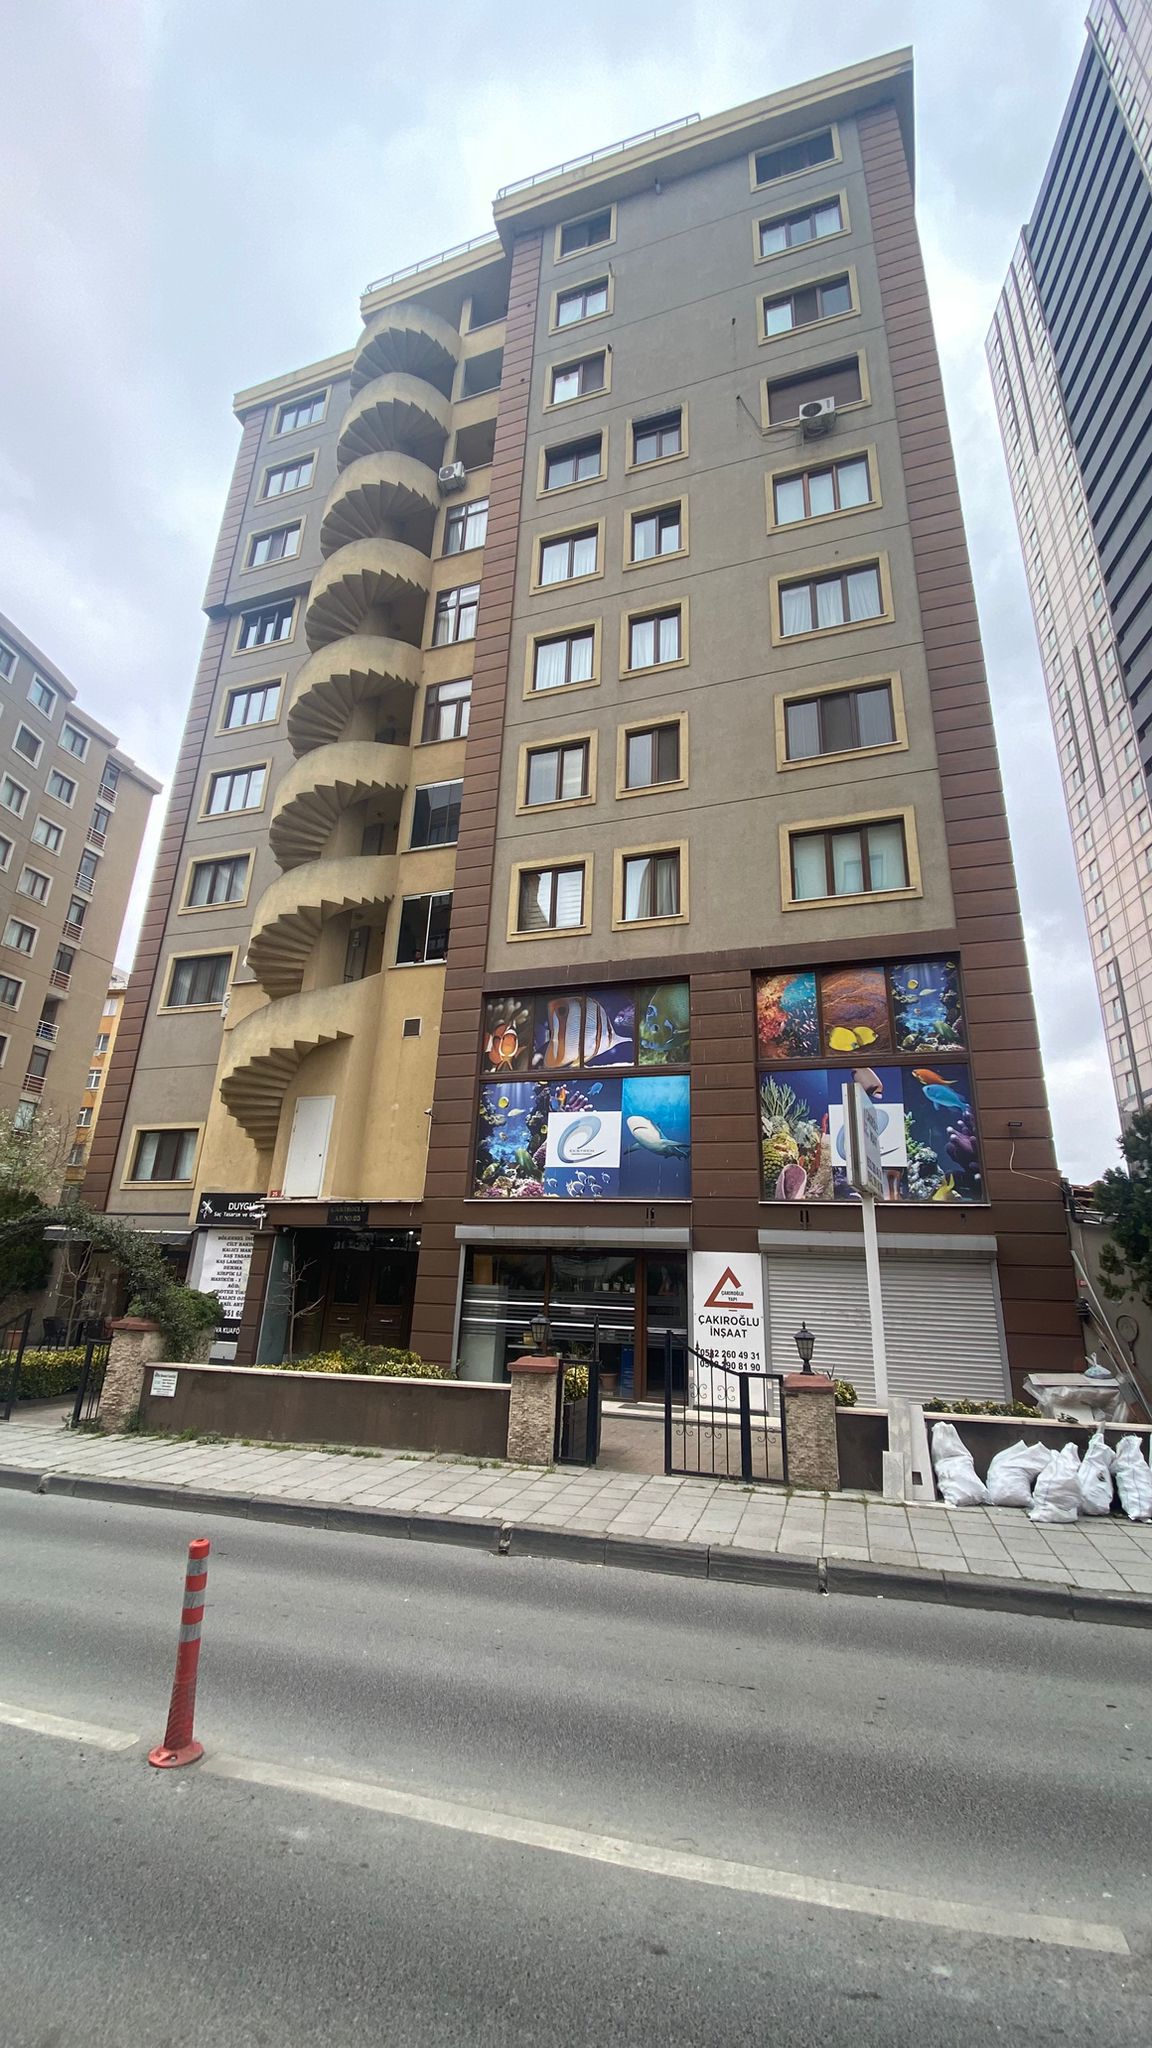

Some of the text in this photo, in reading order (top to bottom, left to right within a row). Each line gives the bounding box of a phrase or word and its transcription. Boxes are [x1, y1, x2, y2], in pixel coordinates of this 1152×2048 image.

[698, 1315, 760, 1327] ÇAKIROĞLU
[710, 1327, 747, 1339] İNŞAAT
[700, 1348, 760, 1360] 052 260 49 31
[738, 1362, 748, 1371] 81
[750, 1363, 761, 1371] 90
